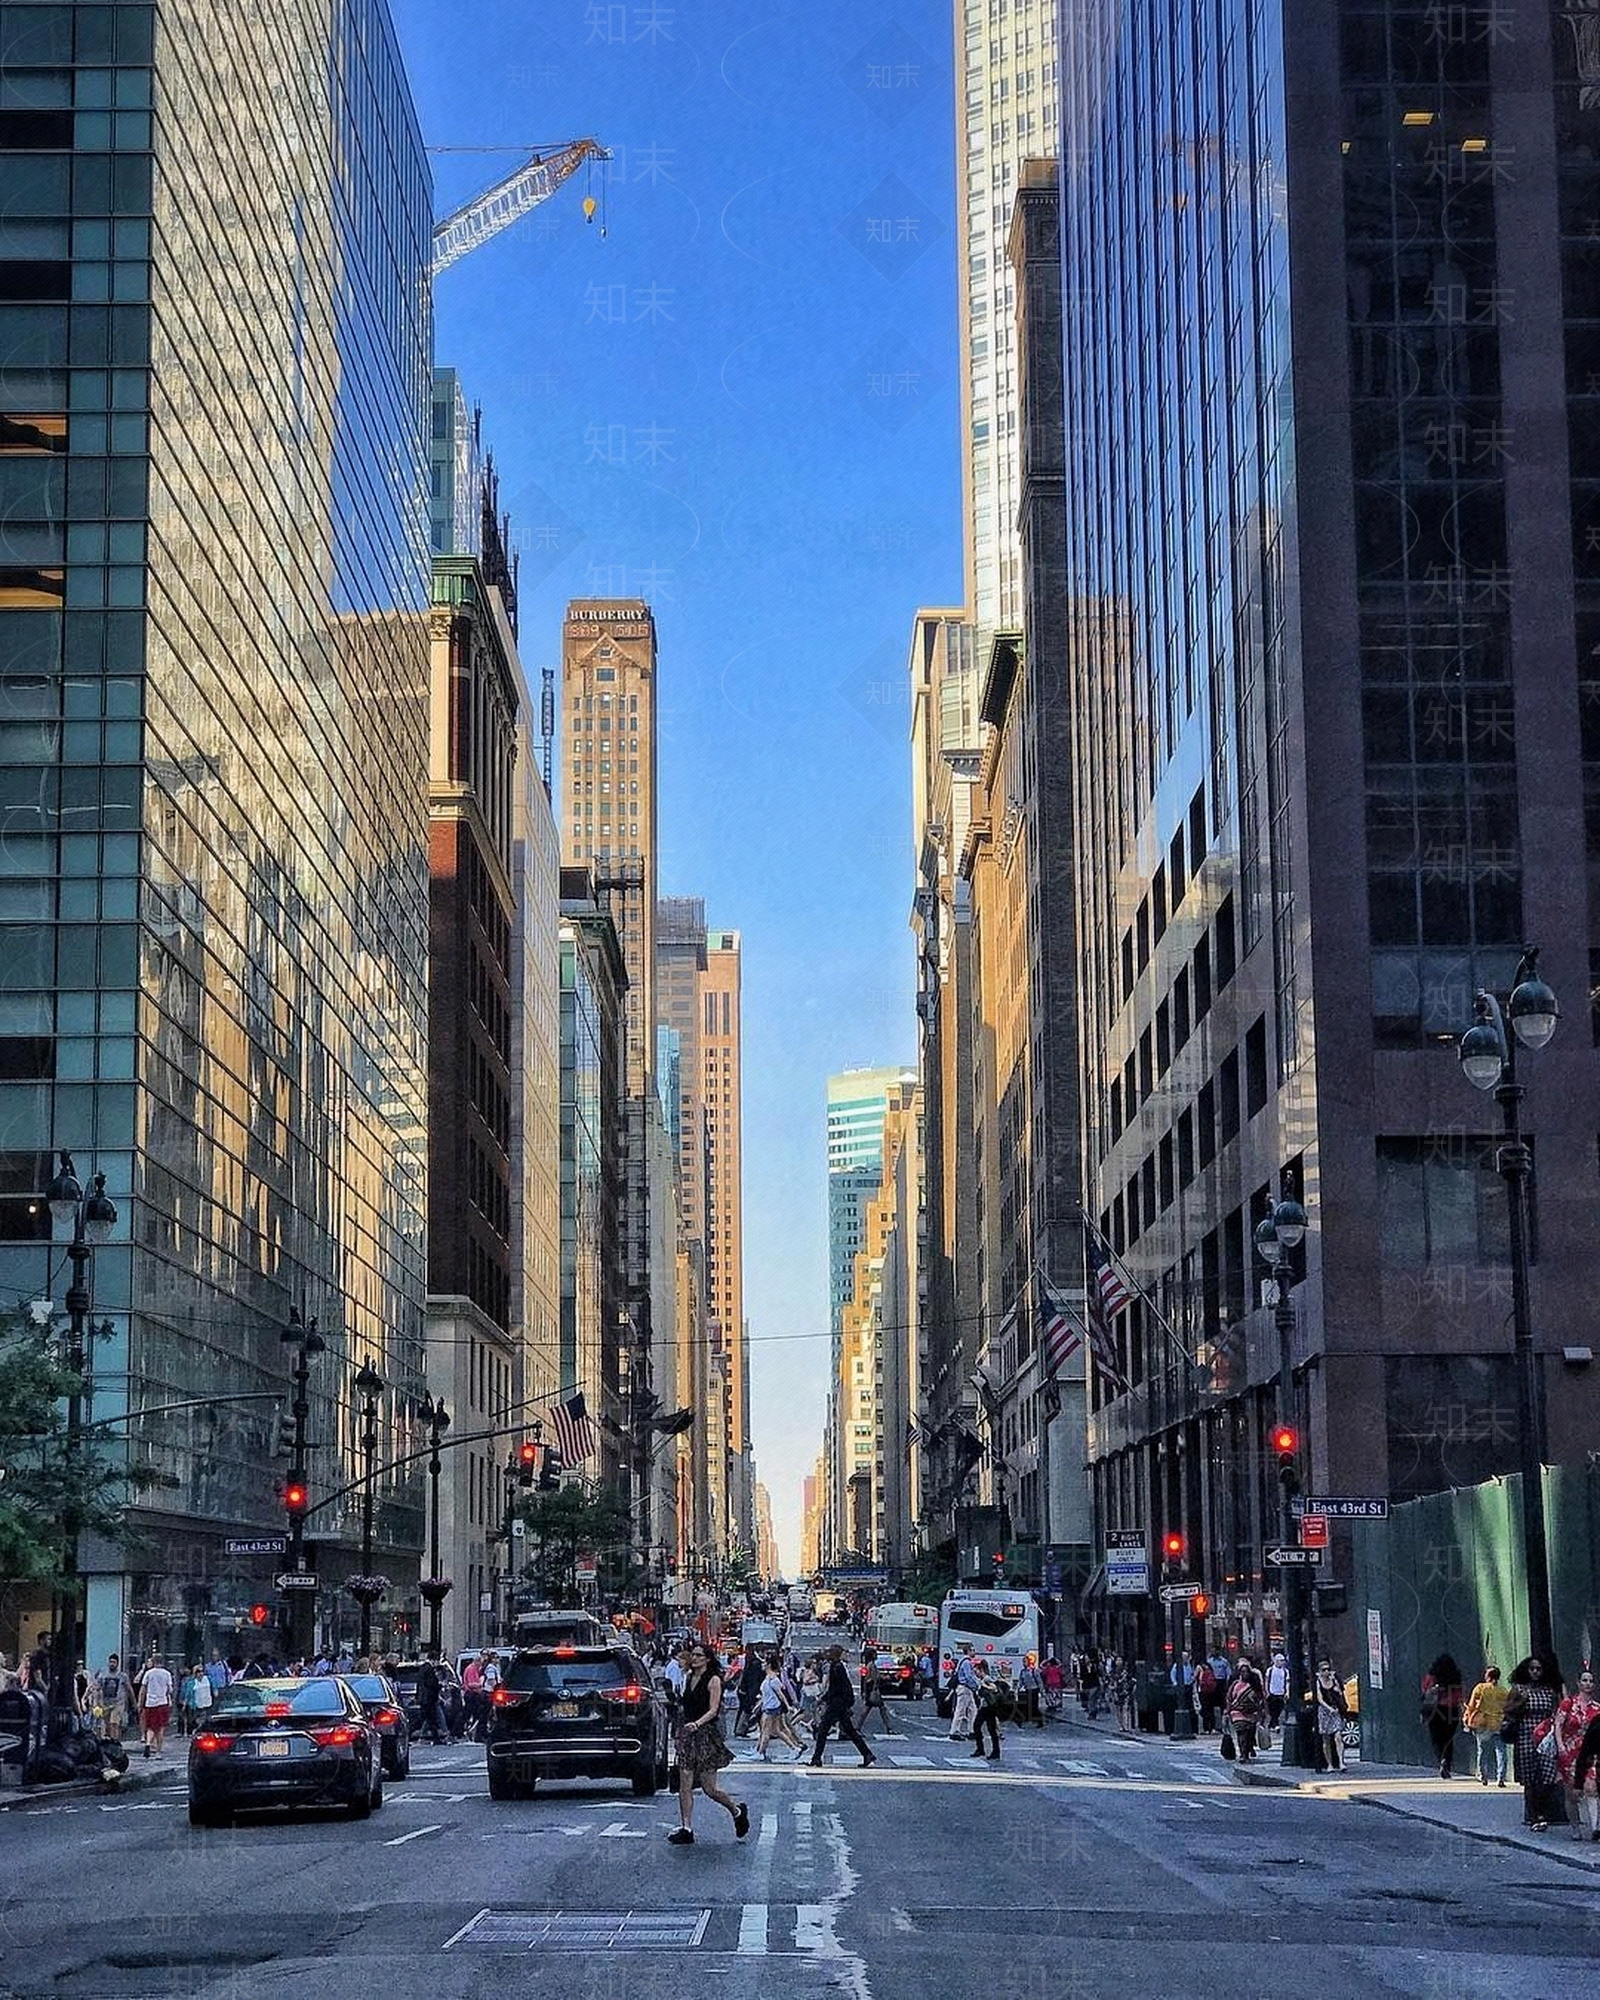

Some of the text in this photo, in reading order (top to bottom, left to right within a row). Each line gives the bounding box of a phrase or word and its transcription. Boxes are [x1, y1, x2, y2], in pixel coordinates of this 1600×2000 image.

[570, 609, 644, 620] BURBERRY
[1312, 1502, 1338, 1514] East
[1340, 1502, 1366, 1514] 43rd
[1369, 1502, 1382, 1514] St
[1111, 1533, 1118, 1542] 2
[229, 1541, 282, 1552] East 43rd St
